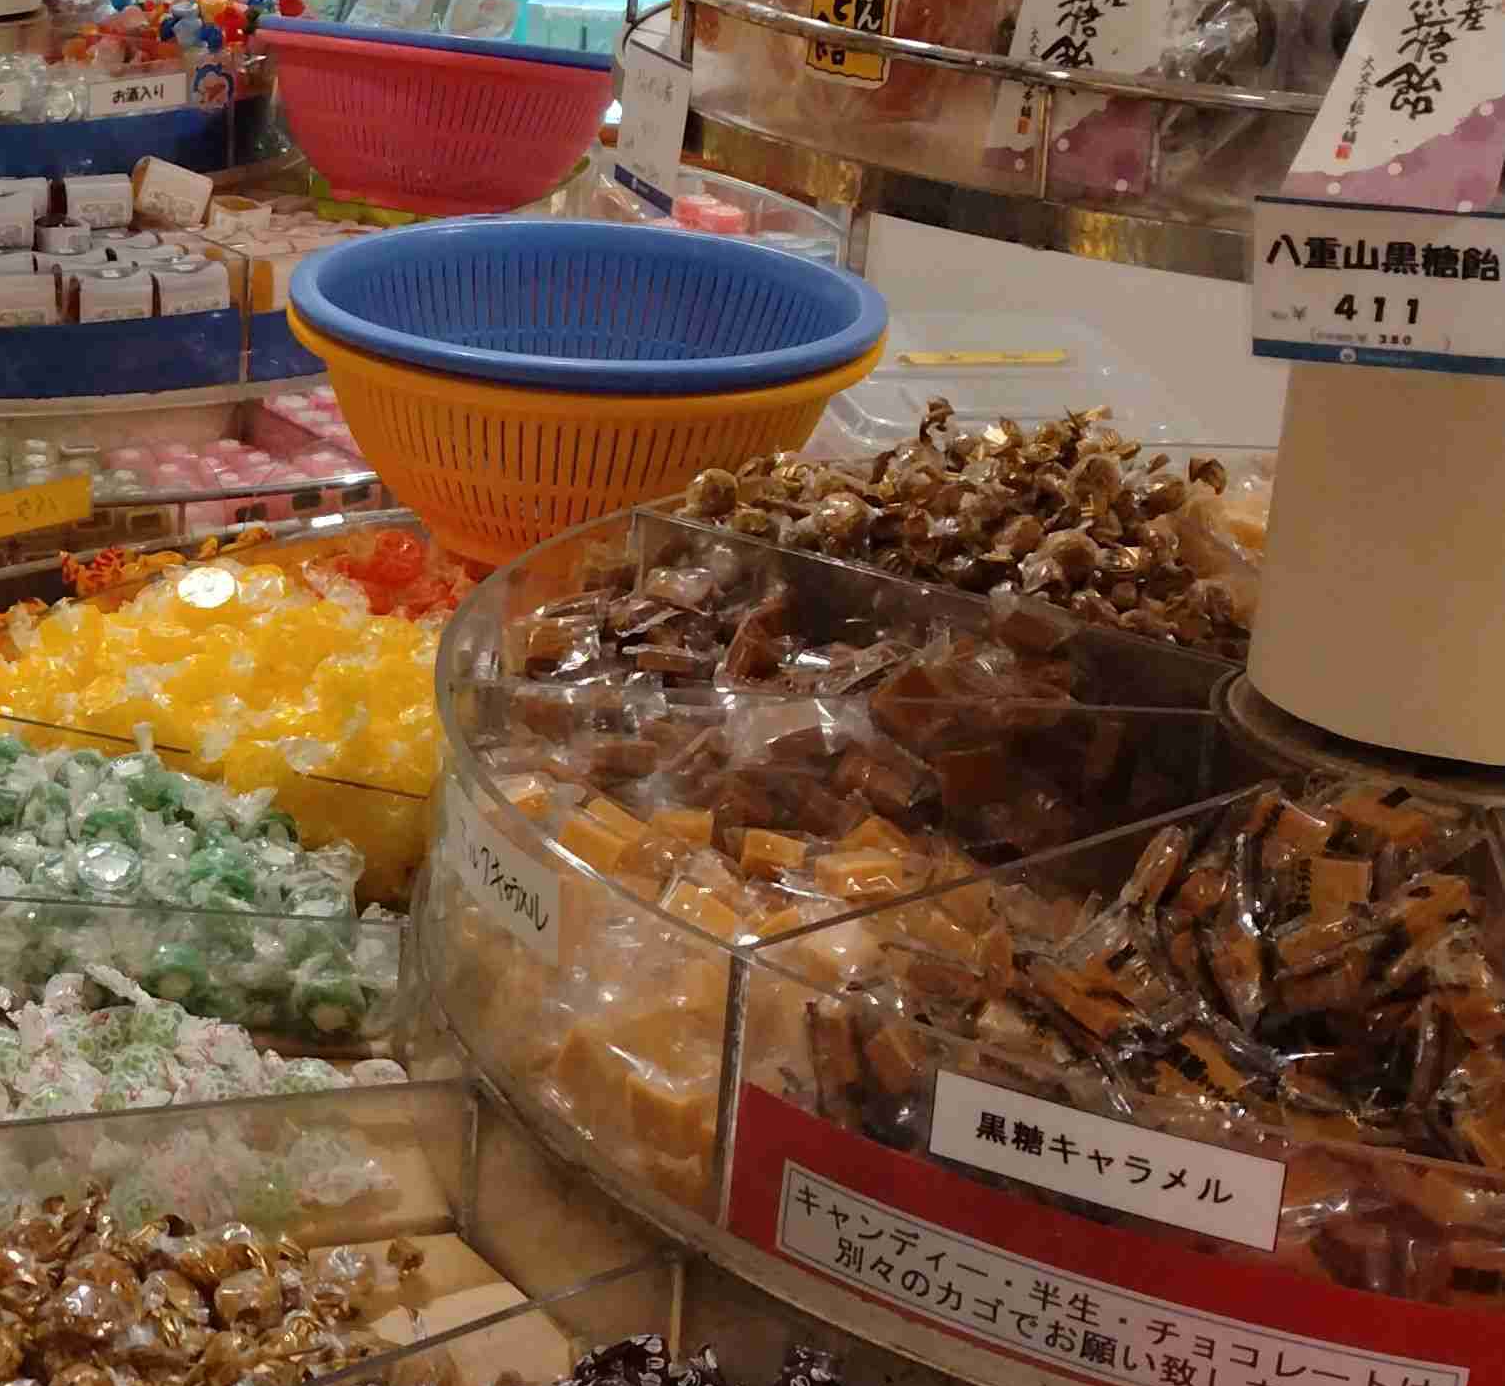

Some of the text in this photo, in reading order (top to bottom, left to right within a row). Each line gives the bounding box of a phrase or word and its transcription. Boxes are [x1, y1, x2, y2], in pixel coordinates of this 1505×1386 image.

[112, 83, 164, 104] お酒入り
[1266, 234, 1500, 281] 八重山黒糖飴
[1334, 294, 1419, 324] 411
[976, 1110, 1234, 1207] 黒糖キャラメル
